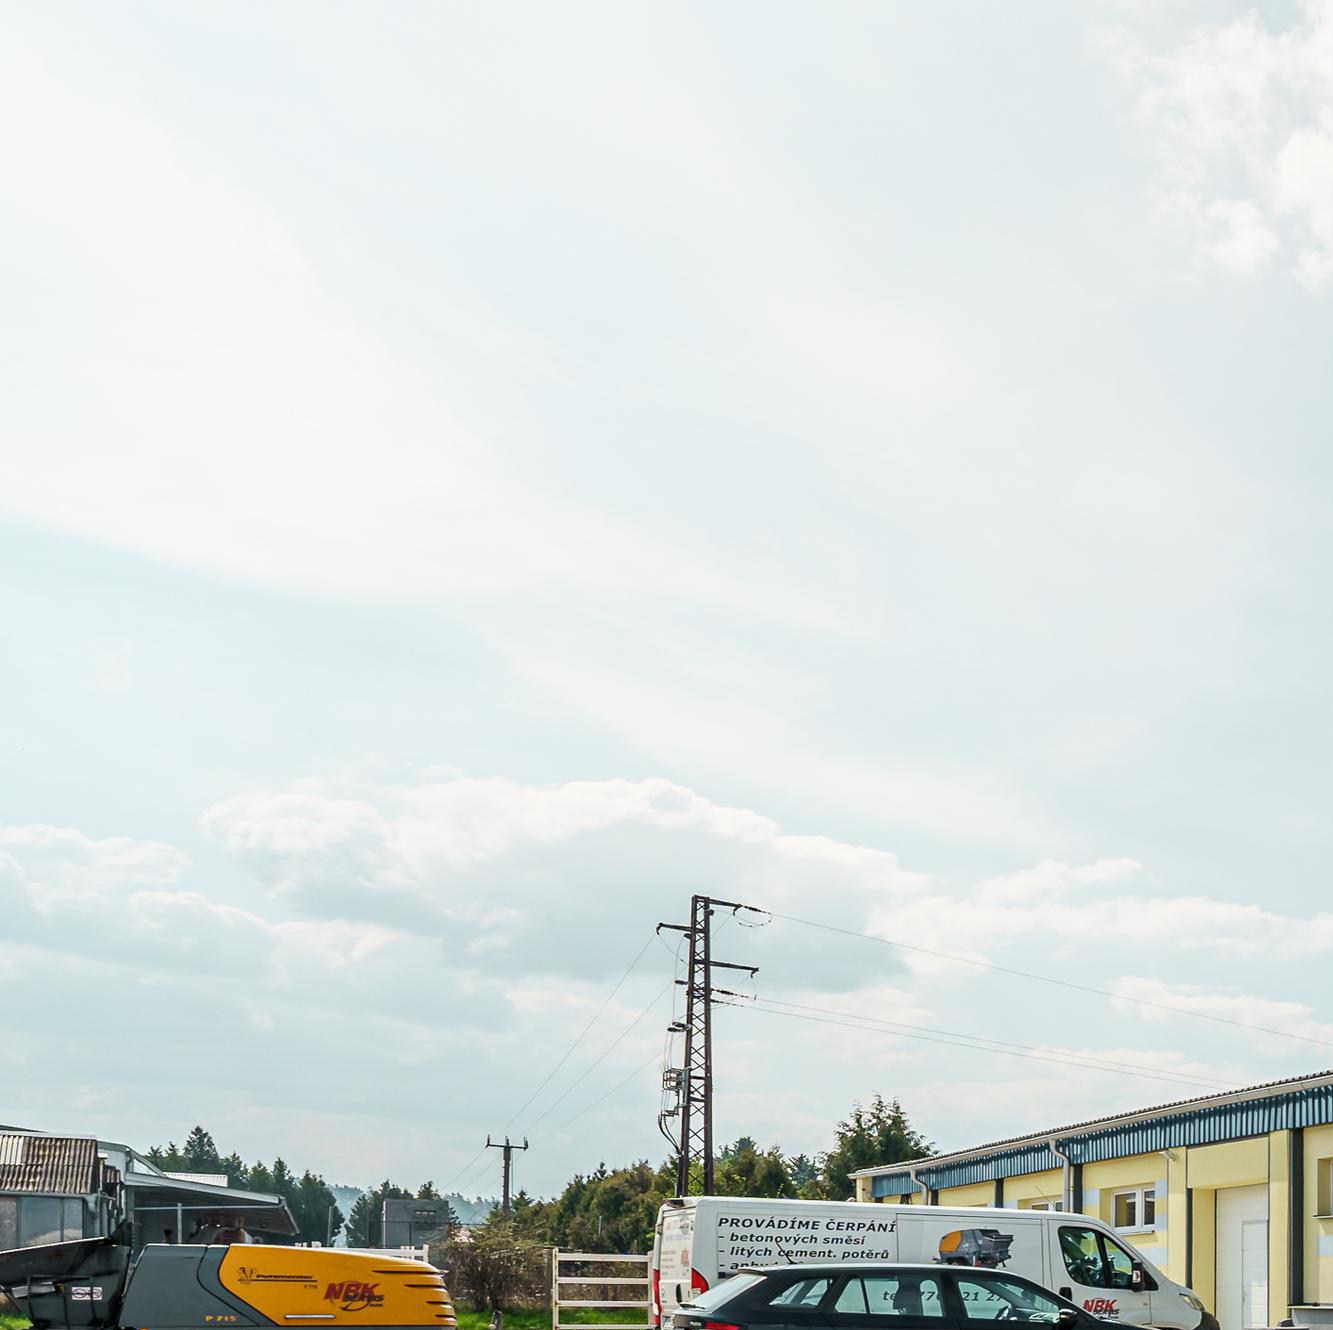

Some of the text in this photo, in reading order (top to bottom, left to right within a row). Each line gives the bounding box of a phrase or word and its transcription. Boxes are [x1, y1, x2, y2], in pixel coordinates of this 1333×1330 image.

[718, 1216, 897, 1233] PROVÁDÍME ČERPÁNÍ
[730, 1232, 818, 1245] betonových
[822, 1235, 866, 1246] směsí
[730, 1246, 773, 1258] litých
[841, 1248, 890, 1262] potěrů
[323, 1281, 381, 1301] NBK
[1083, 1299, 1117, 1313] NBK
